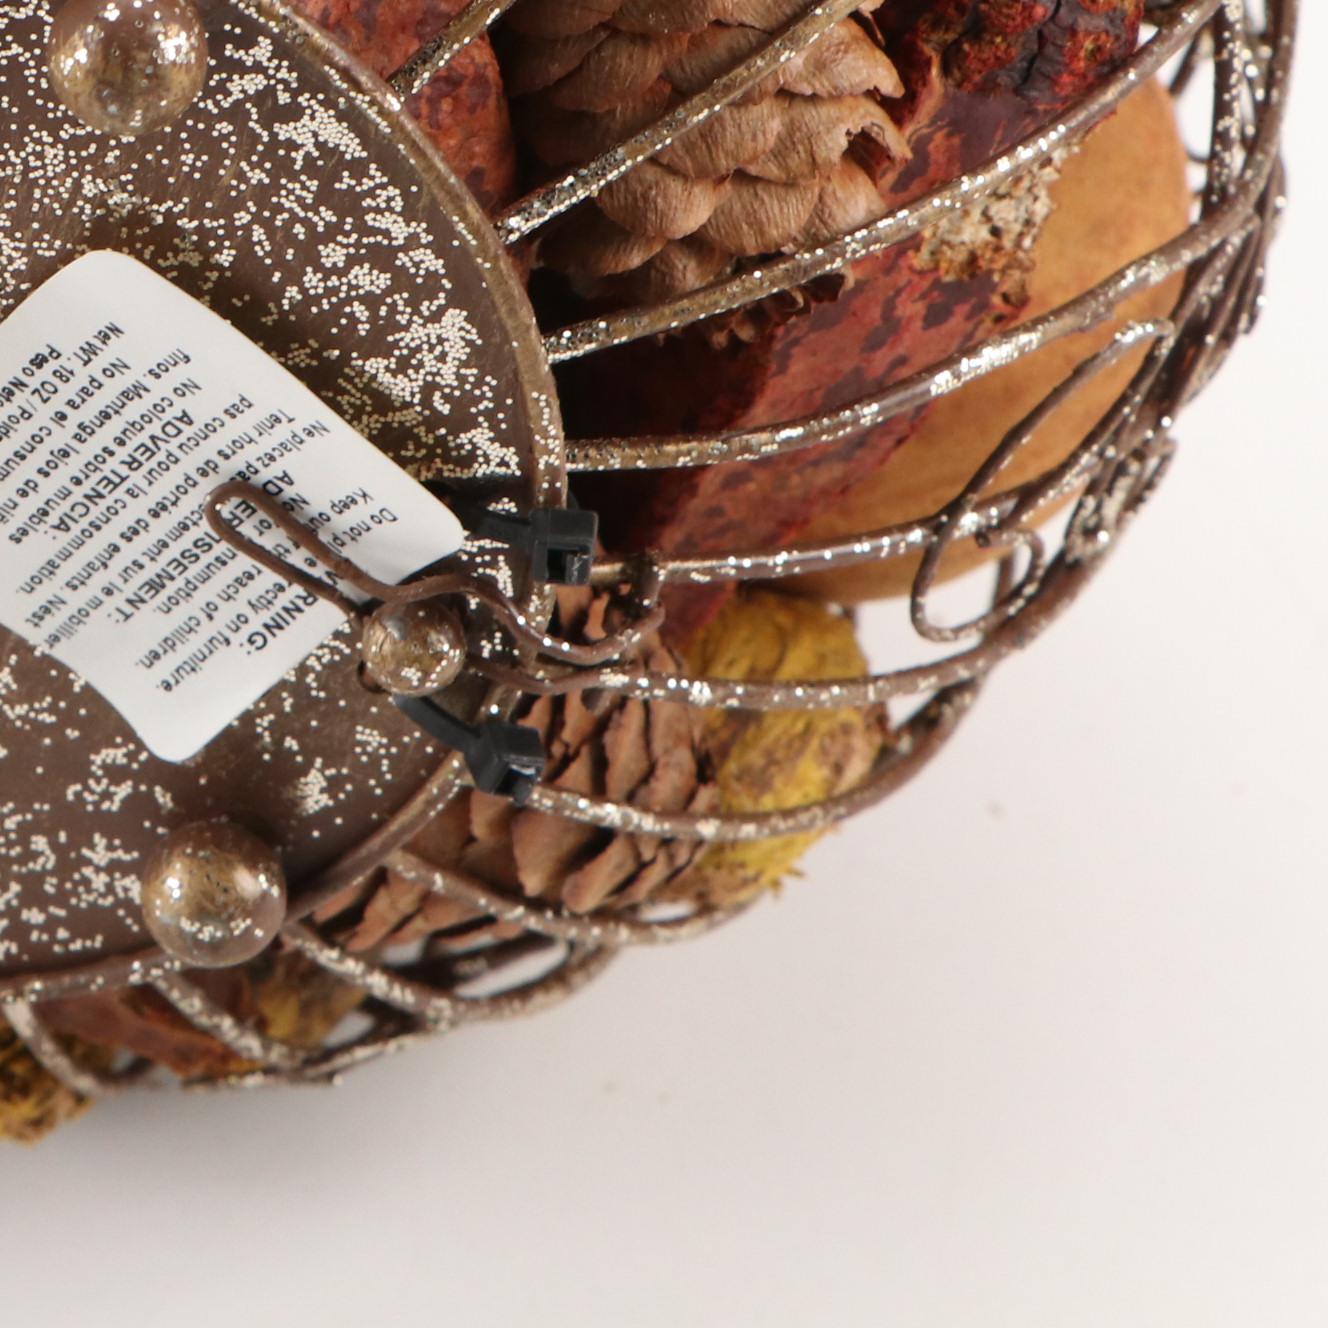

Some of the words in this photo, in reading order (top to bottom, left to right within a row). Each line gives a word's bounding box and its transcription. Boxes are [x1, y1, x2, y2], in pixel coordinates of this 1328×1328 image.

[92, 320, 125, 348] Net
[20, 342, 63, 380] Peso
[50, 362, 77, 386] 18
[100, 355, 132, 382] No
[142, 346, 192, 384] finos.
[29, 378, 60, 406] OZ
[63, 373, 105, 413] para
[171, 375, 203, 401] No
[48, 408, 70, 429] el
[68, 377, 152, 446] Mantenga
[110, 394, 176, 449] coloque
[222, 392, 255, 422] pas
[252, 406, 296, 439] Tenir
[176, 414, 226, 457] concu
[215, 429, 259, 463] hors
[301, 418, 331, 441] Ne
[33, 439, 81, 481] lejos
[68, 444, 118, 490] sobre
[255, 428, 307, 472] placez
[140, 448, 181, 489] pour
[194, 457, 221, 482] de
[14, 477, 41, 501] de
[123, 481, 149, 502] la
[146, 471, 200, 523] portée
[279, 490, 311, 520] No
[328, 486, 374, 517] Keep
[7, 483, 75, 547] muebles
[117, 516, 152, 546] des
[251, 513, 280, 539] or
[341, 517, 373, 544] not
[369, 506, 399, 526] Do
[14, 496, 129, 598] consommation.
[106, 468, 296, 627] ADERISSEMENT:
[140, 502, 211, 565] ctement
[302, 530, 349, 572] ple
[60, 540, 124, 595] enfants.
[268, 540, 293, 564] th
[116, 557, 146, 585] sur
[152, 543, 239, 618] nsumption.
[216, 562, 264, 605] reach
[99, 580, 124, 600] le
[246, 573, 295, 617] ectly
[42, 594, 106, 652] mobilier
[199, 599, 221, 623] of
[224, 611, 250, 635] on
[238, 565, 345, 657] RNING:
[135, 614, 203, 673] children.
[155, 629, 232, 696] furniture.
